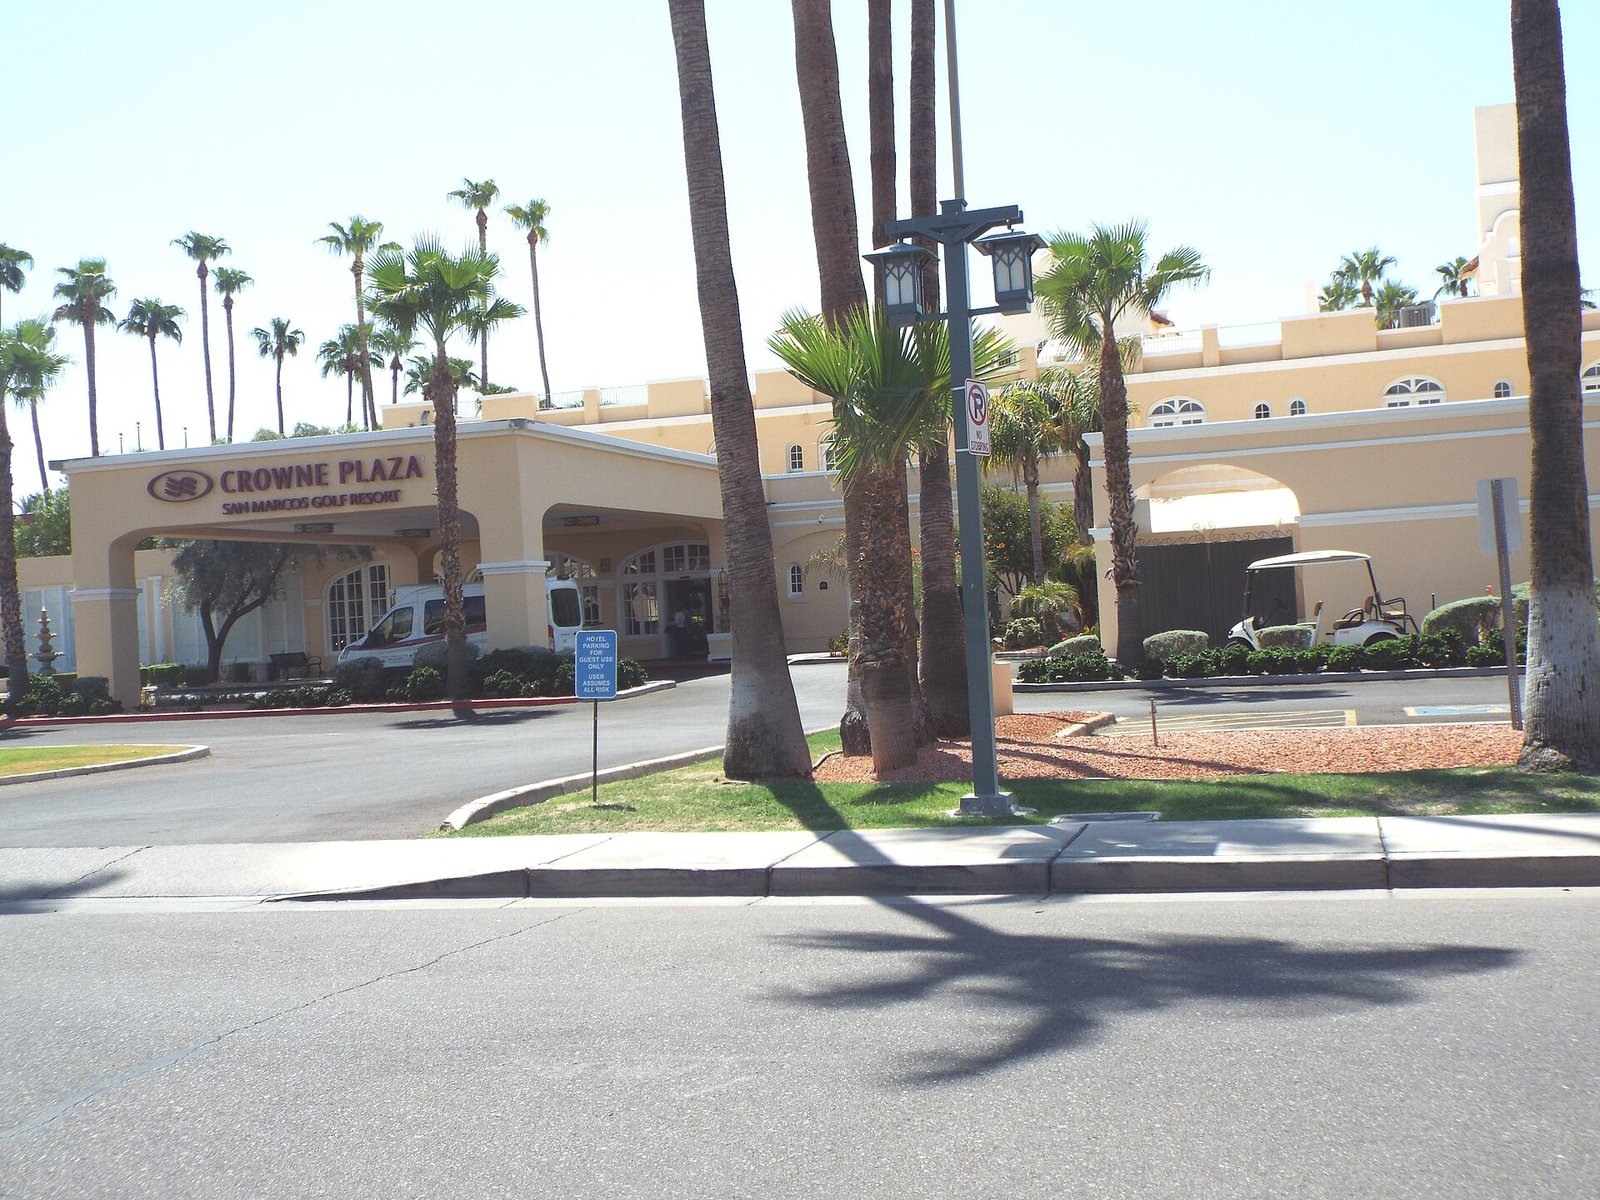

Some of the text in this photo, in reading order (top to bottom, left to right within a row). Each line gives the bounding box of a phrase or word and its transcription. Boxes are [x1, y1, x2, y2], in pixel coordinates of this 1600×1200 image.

[220, 455, 423, 494] CROWNE PLAZA
[222, 489, 402, 515] SAN MARCOS GOLF RESORT
